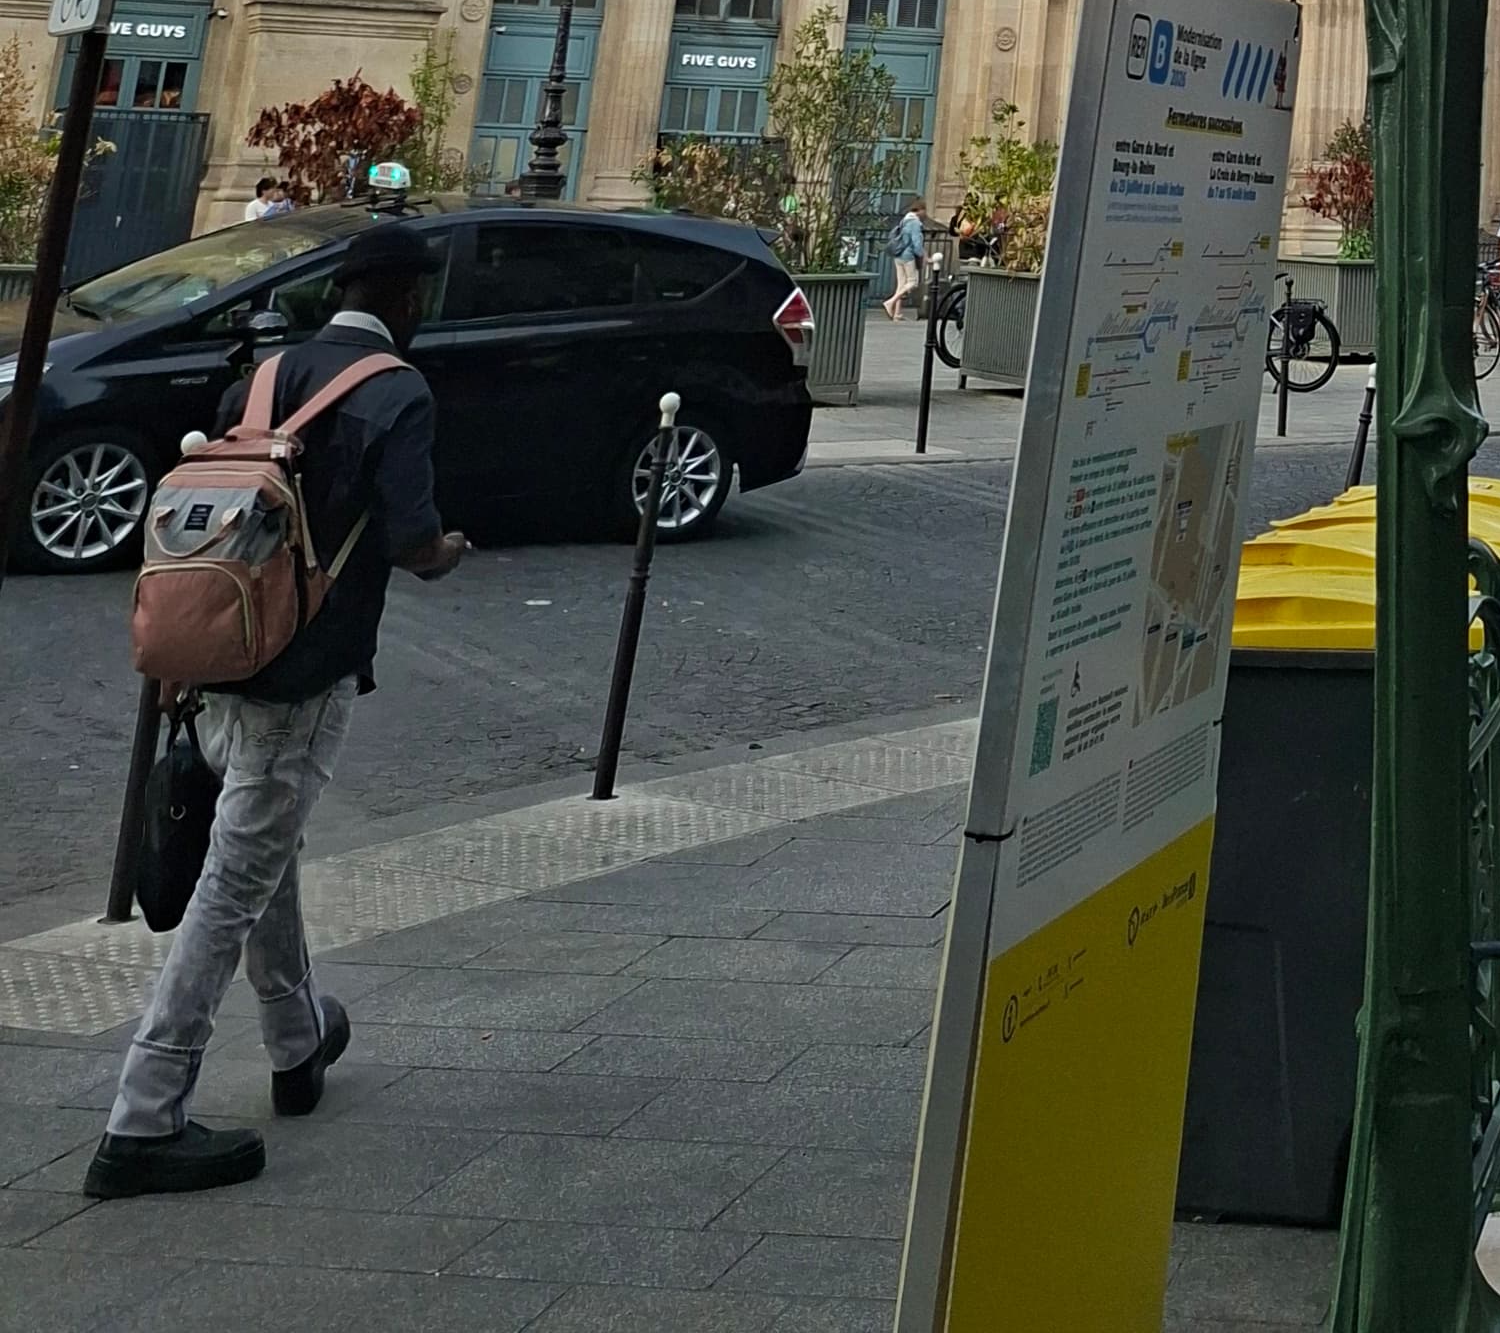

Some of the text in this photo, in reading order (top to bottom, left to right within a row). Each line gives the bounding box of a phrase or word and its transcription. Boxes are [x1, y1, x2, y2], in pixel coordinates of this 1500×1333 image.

[110, 21, 187, 38] VE GUYS
[1131, 34, 1148, 59] RER
[1155, 35, 1168, 70] B
[681, 53, 757, 69] FIVE GUYS
